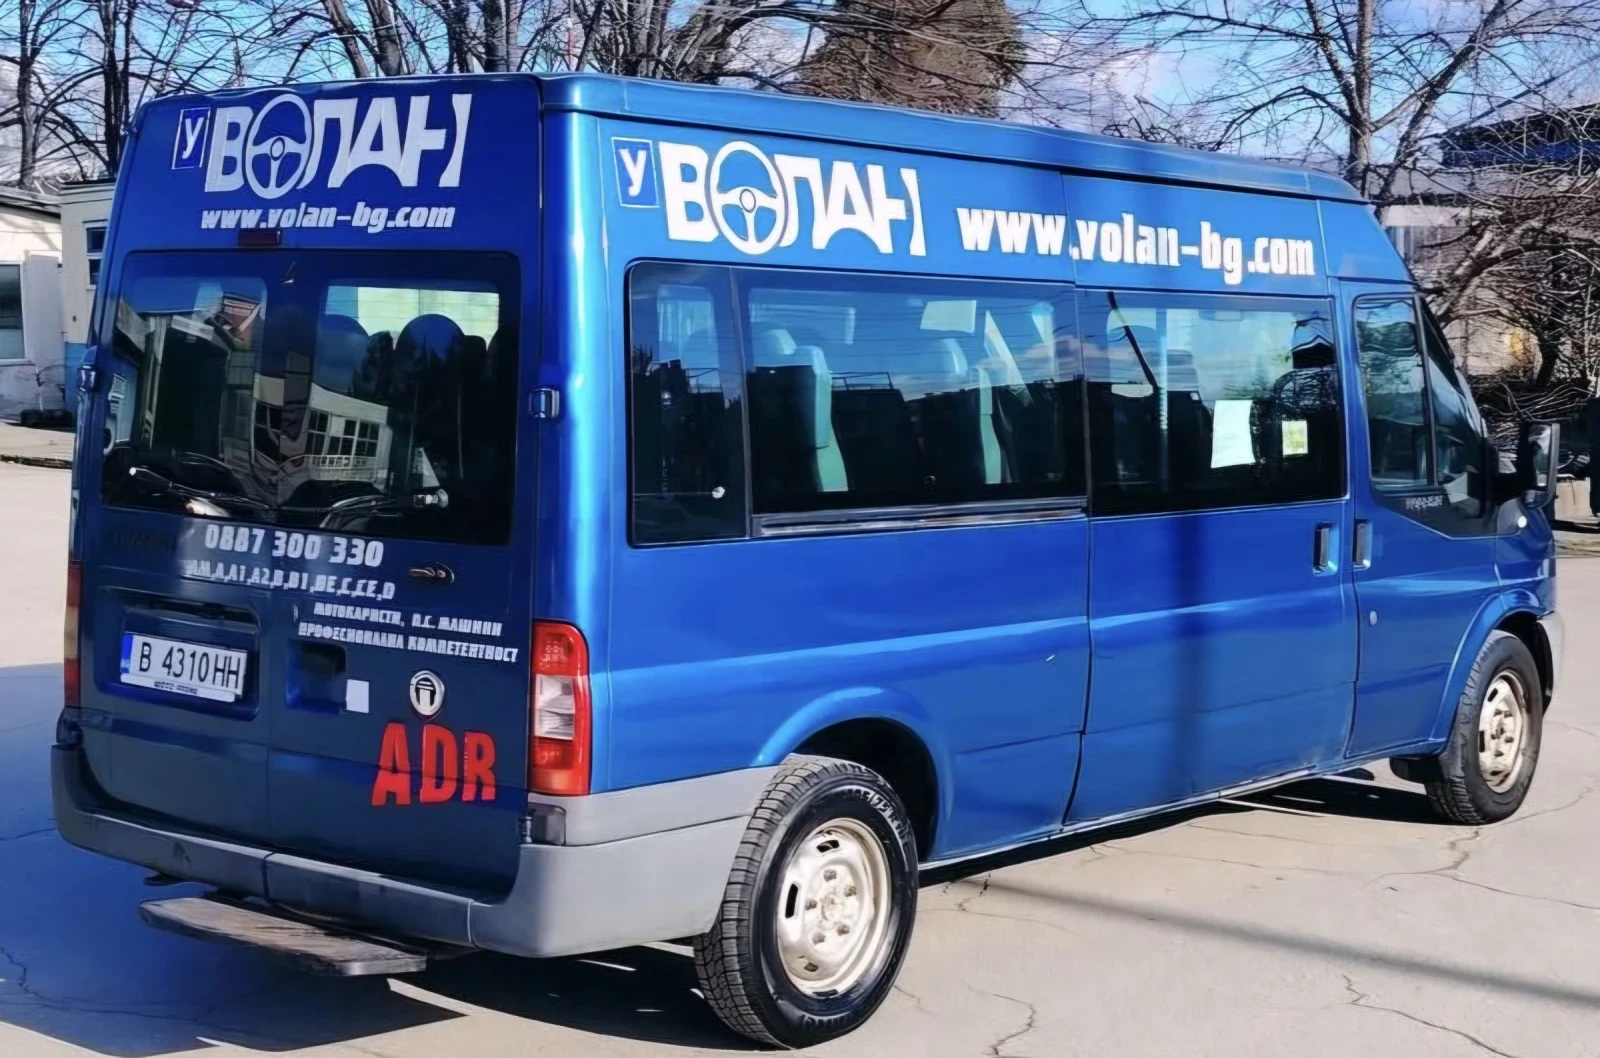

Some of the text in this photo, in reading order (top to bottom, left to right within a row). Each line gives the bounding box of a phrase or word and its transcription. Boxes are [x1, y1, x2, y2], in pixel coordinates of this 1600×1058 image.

[201, 202, 456, 233] www.volan-bg.com
[956, 207, 1315, 285] www.volan-bg.com
[205, 524, 384, 568] 0887 300 330
[371, 722, 497, 806] ADR
